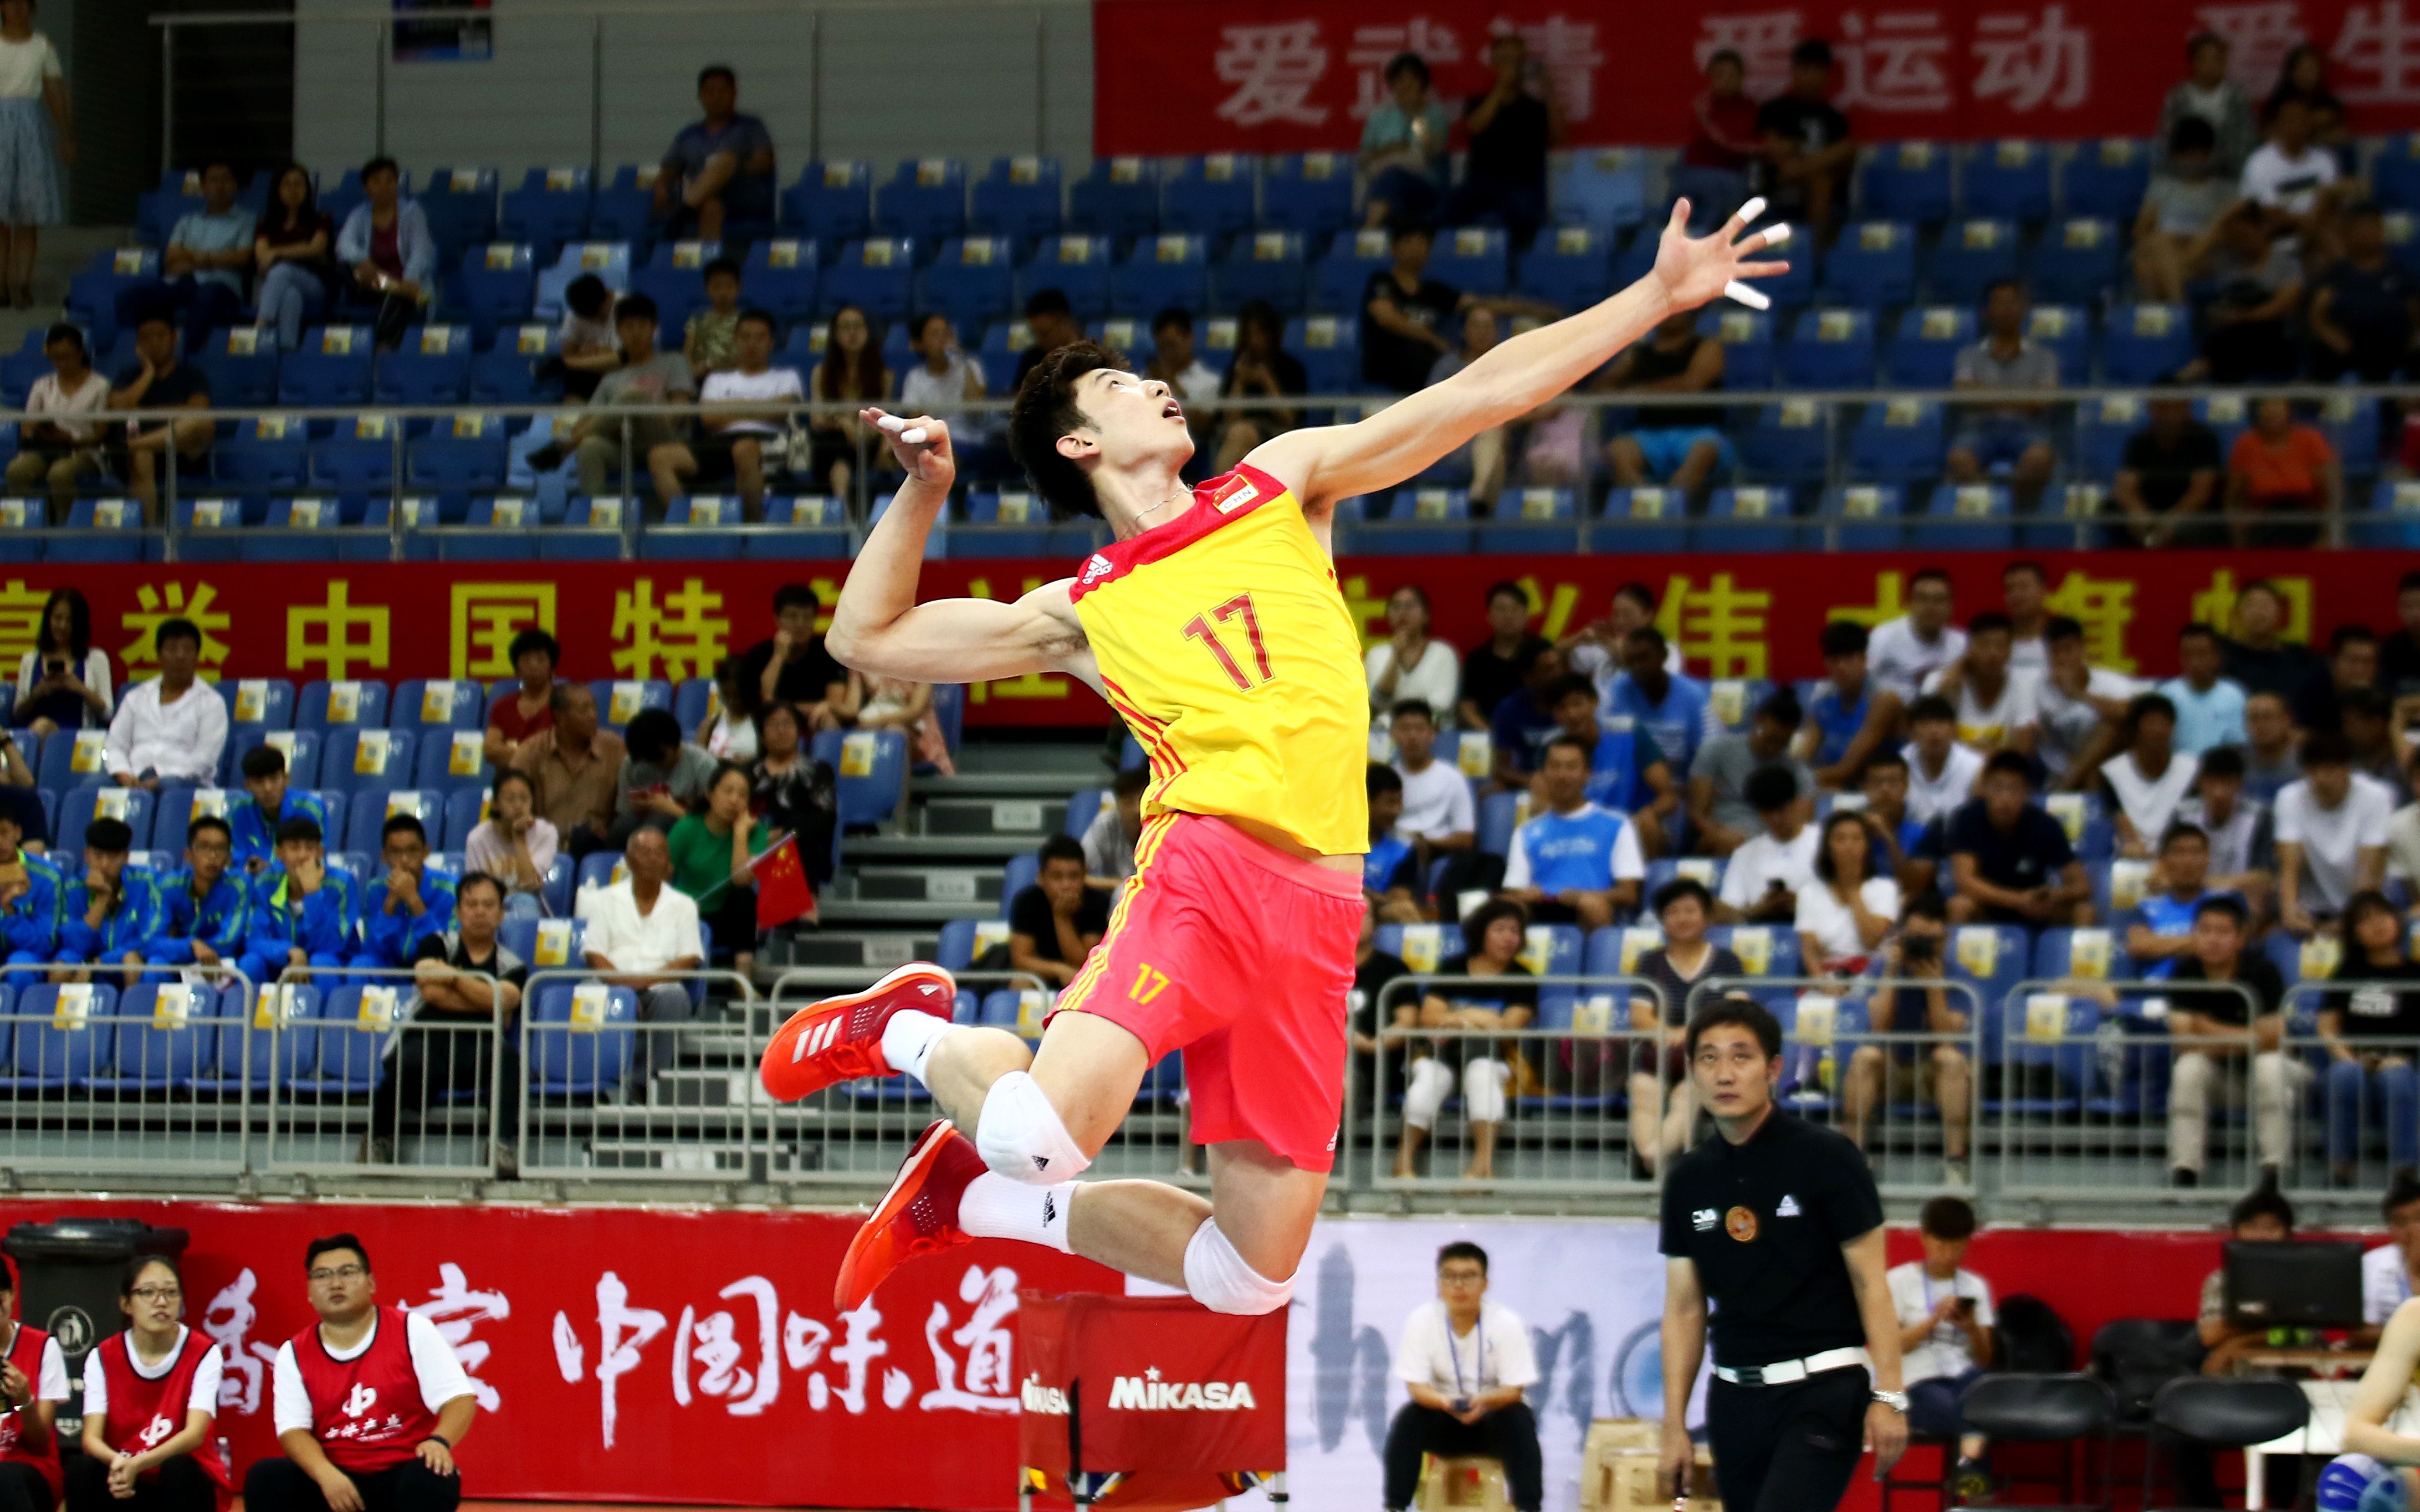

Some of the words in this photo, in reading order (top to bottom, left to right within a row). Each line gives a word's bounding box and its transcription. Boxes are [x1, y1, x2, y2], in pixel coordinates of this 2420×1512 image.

[1694, 2, 2090, 112] 爱运动
[1224, 489, 1252, 509] CHN
[1180, 591, 1276, 693] 17
[1128, 962, 1170, 1006] 17
